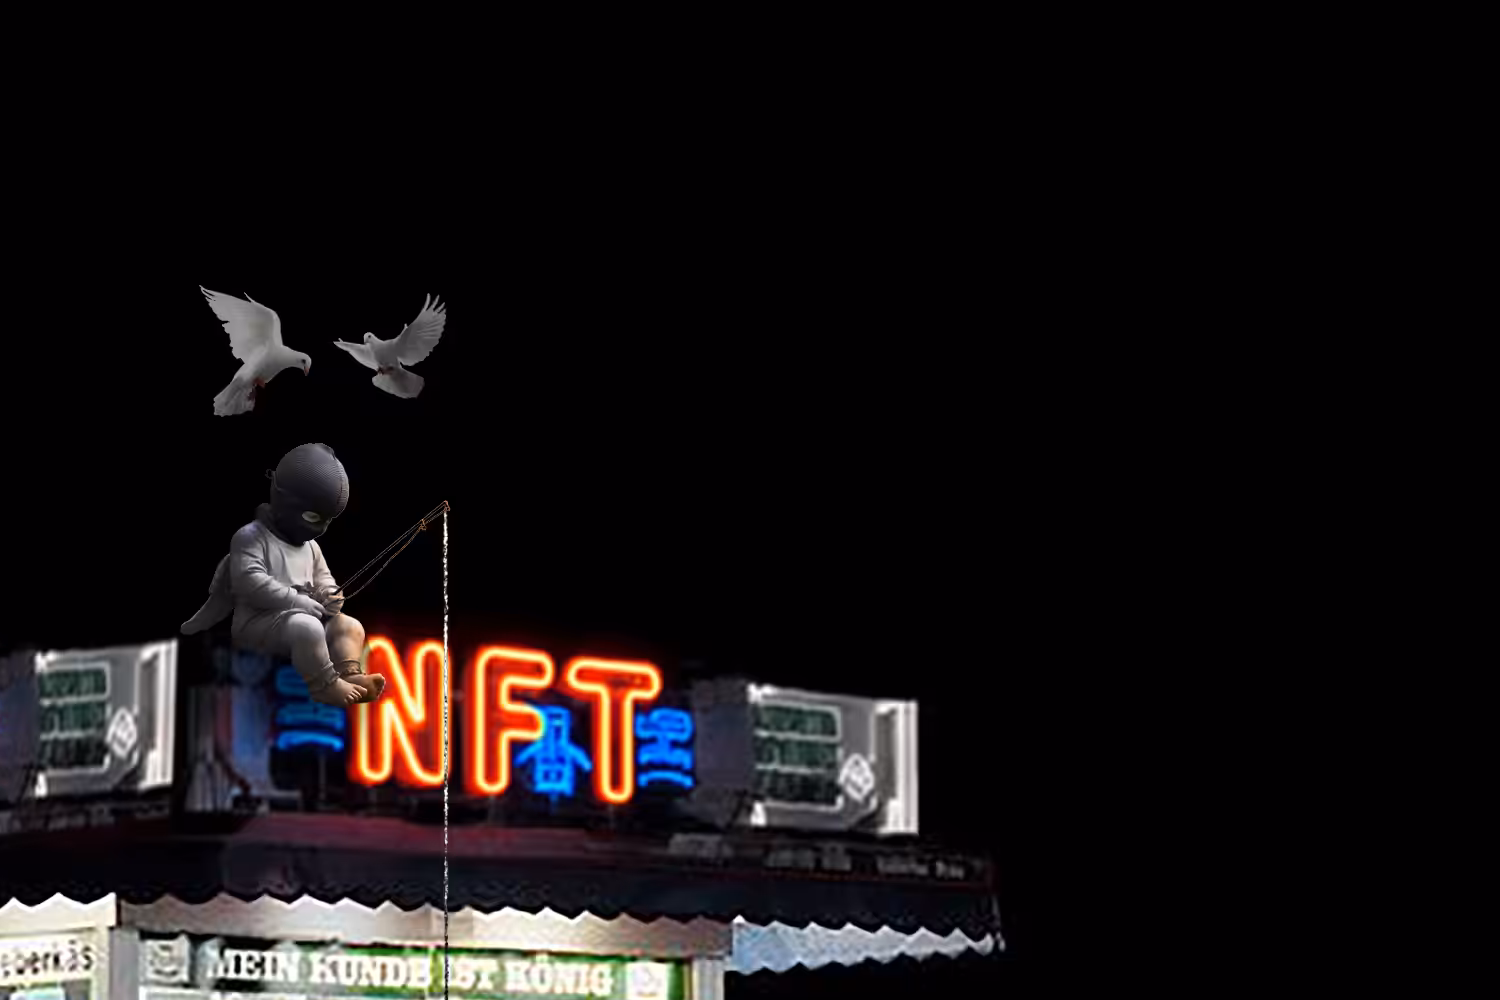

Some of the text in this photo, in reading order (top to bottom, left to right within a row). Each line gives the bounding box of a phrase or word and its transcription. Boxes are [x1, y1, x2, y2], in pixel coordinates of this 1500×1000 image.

[351, 637, 662, 804] NFT
[206, 948, 301, 984] MEIN
[306, 952, 432, 989] KUNDE
[503, 952, 613, 997] KÖNIG
